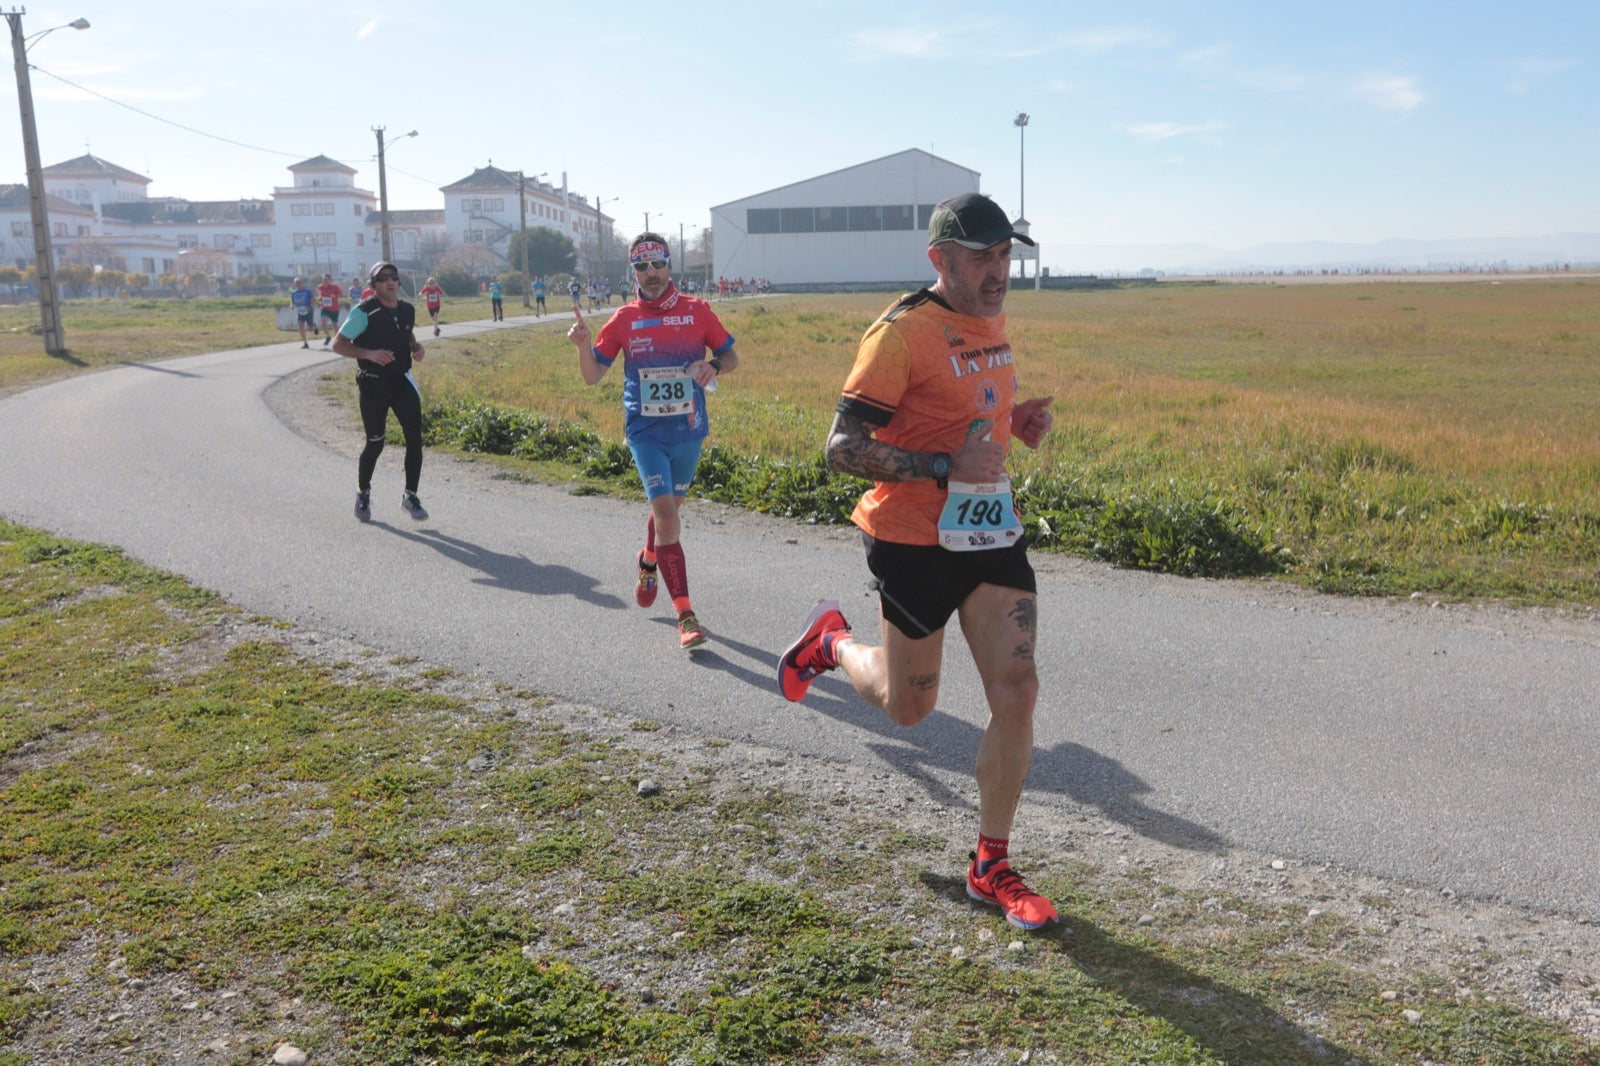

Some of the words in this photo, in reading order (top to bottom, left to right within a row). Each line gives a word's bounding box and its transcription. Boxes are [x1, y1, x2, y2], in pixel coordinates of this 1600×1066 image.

[663, 316, 694, 326] SEUR
[960, 349, 982, 360] Club
[649, 382, 685, 400] 238
[957, 499, 1003, 526] 190
